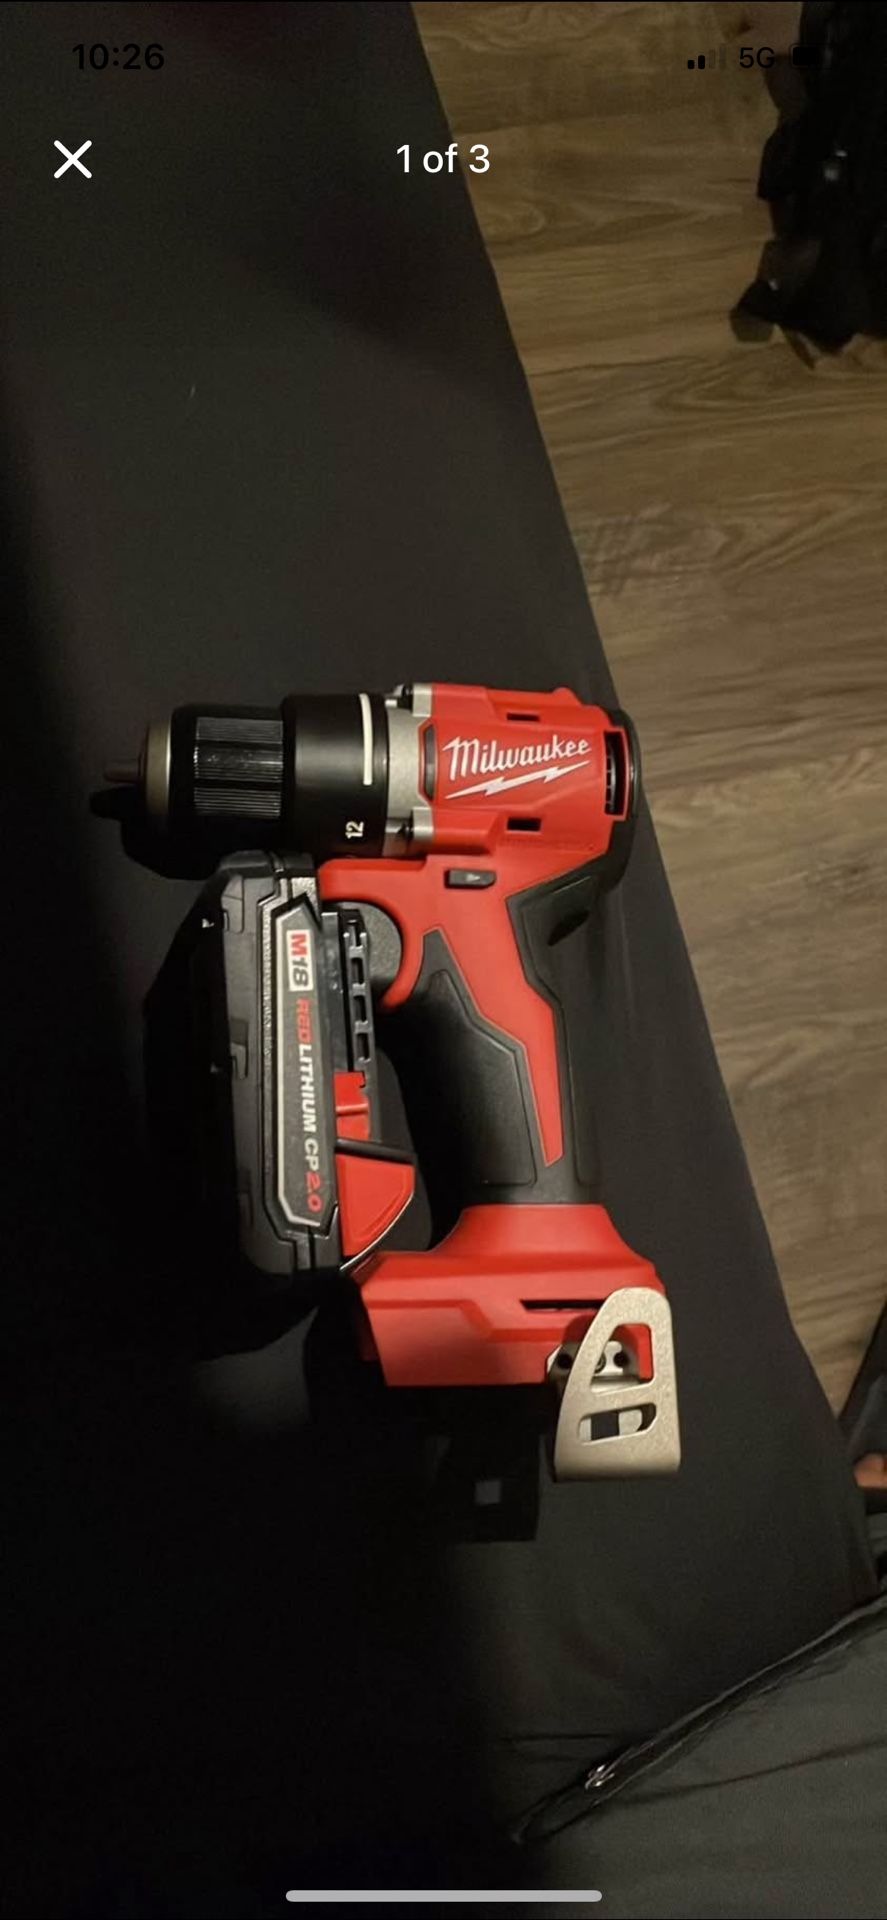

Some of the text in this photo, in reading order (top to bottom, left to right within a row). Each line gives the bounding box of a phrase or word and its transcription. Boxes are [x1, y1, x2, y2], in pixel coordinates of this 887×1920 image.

[442, 734, 592, 781] Milwaukee
[344, 820, 364, 839] 12
[290, 933, 309, 987] M18
